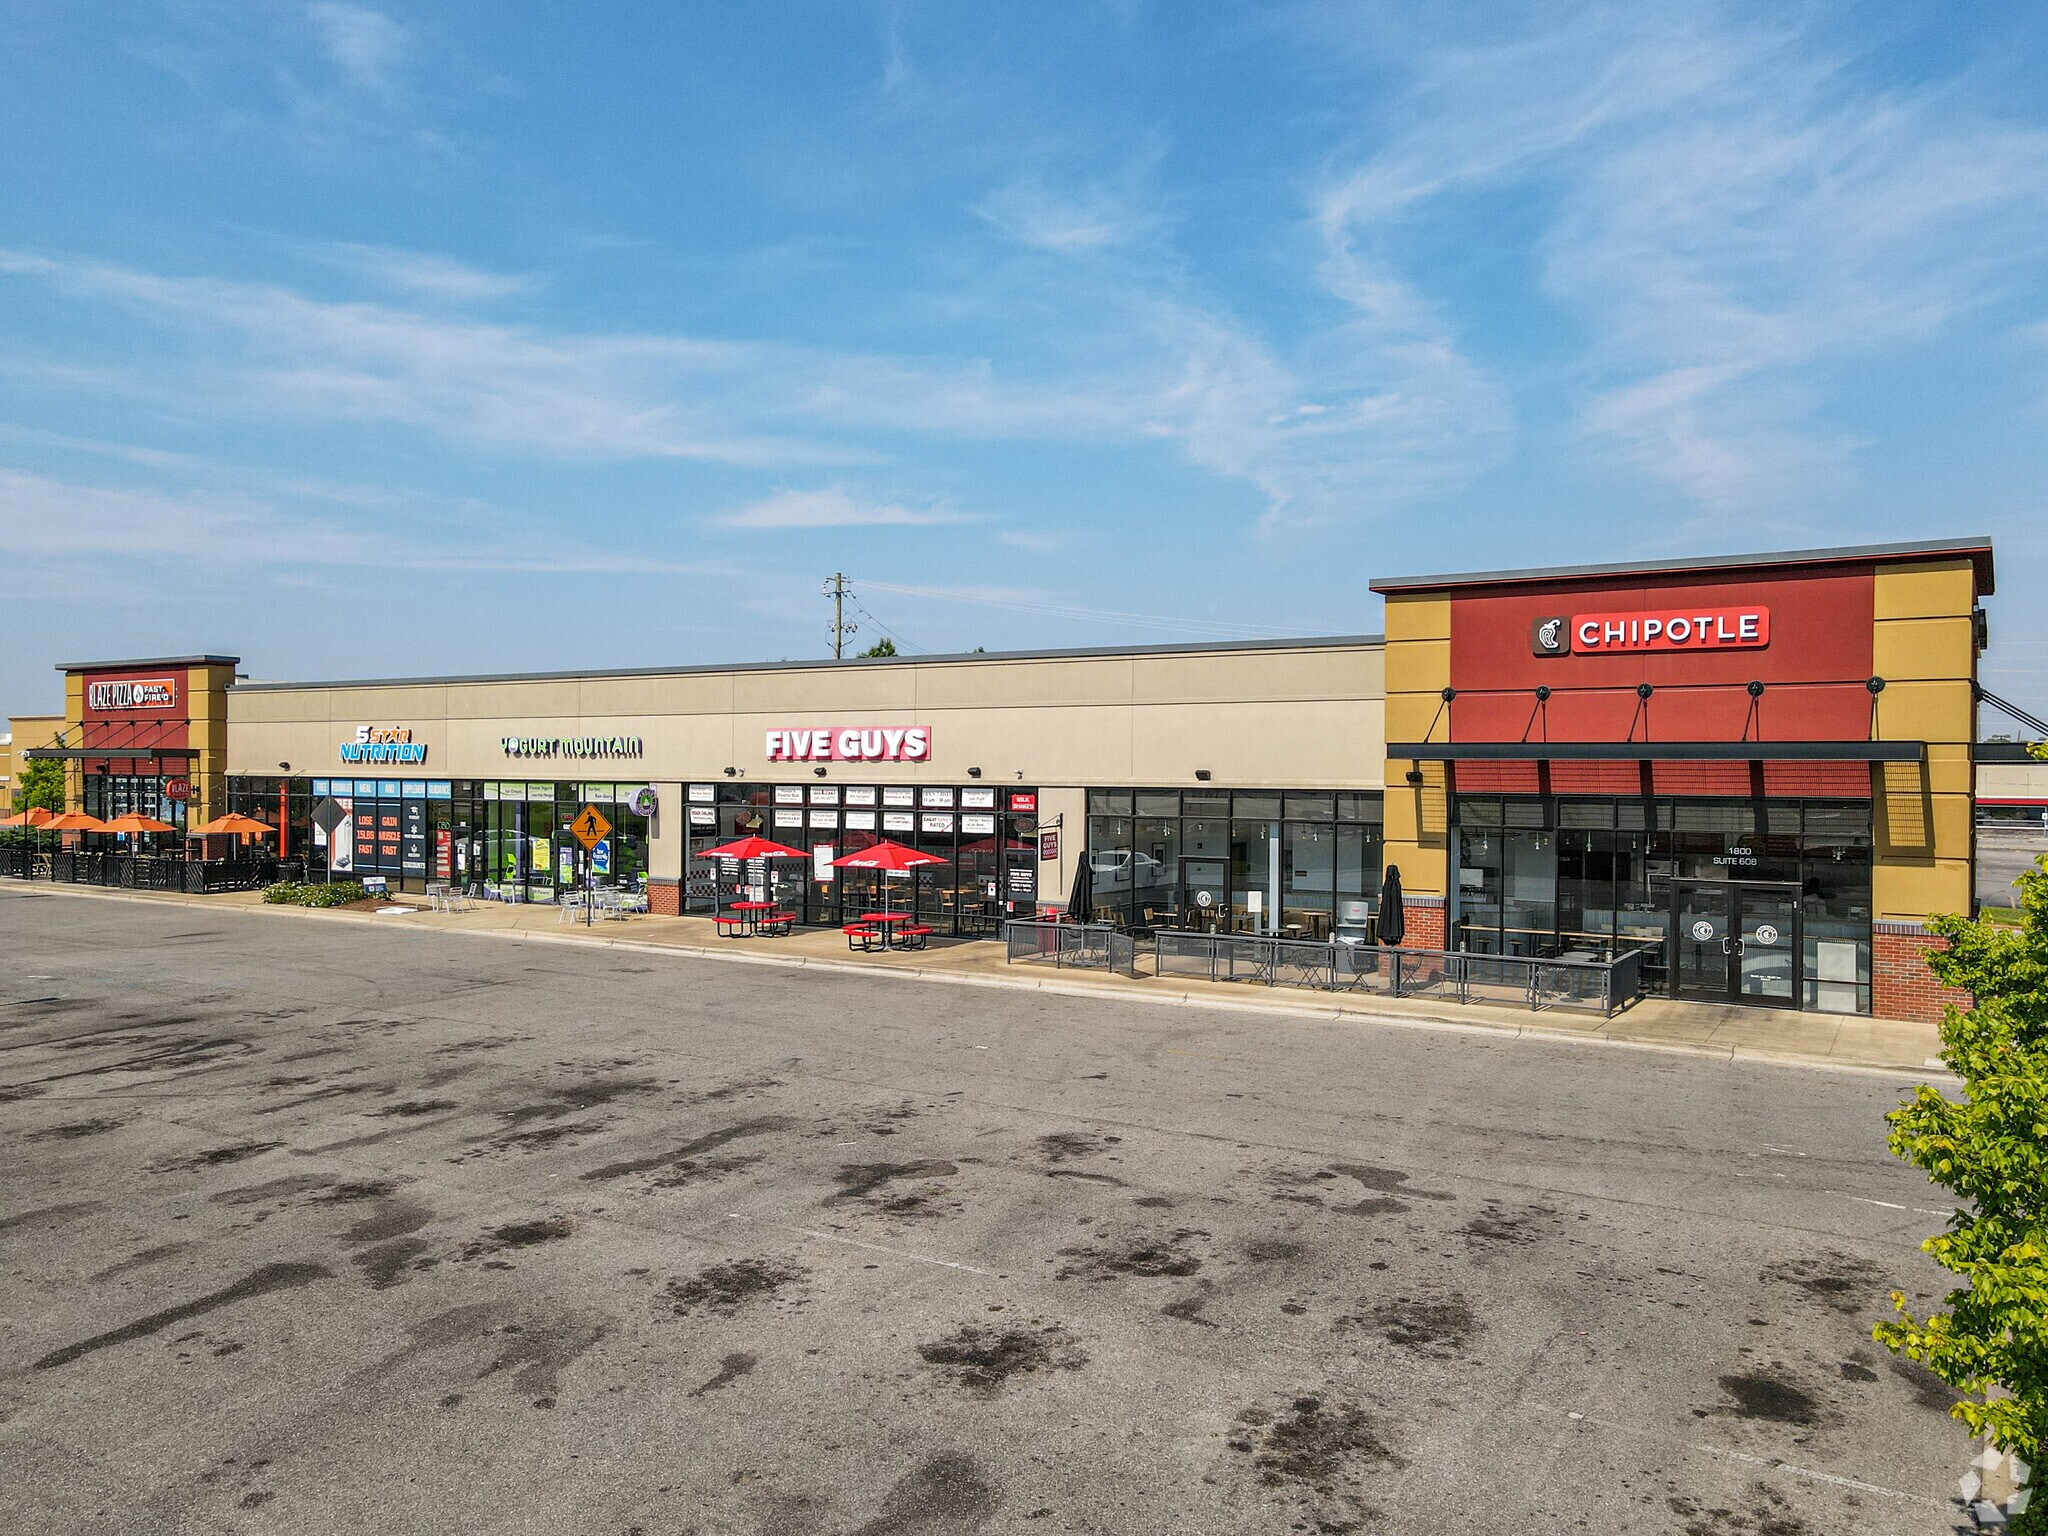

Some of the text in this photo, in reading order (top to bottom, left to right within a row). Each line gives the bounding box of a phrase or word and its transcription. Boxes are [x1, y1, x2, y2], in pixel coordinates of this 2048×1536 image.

[1579, 614, 1759, 644] CHIPOTLE
[89, 683, 133, 707] BLAZE PIZZA
[499, 736, 640, 754] YOGURT MOUNTAIN
[765, 729, 927, 757] FIVE GUYS
[339, 743, 425, 761] NUTRITION
[358, 816, 373, 826] LOSE
[381, 816, 398, 827] GAIN
[378, 831, 401, 841] MUSCLE
[358, 844, 373, 855] FAST
[382, 845, 397, 855] FAST
[1729, 847, 1752, 855] 1800
[1713, 856, 1738, 865] SUITE
